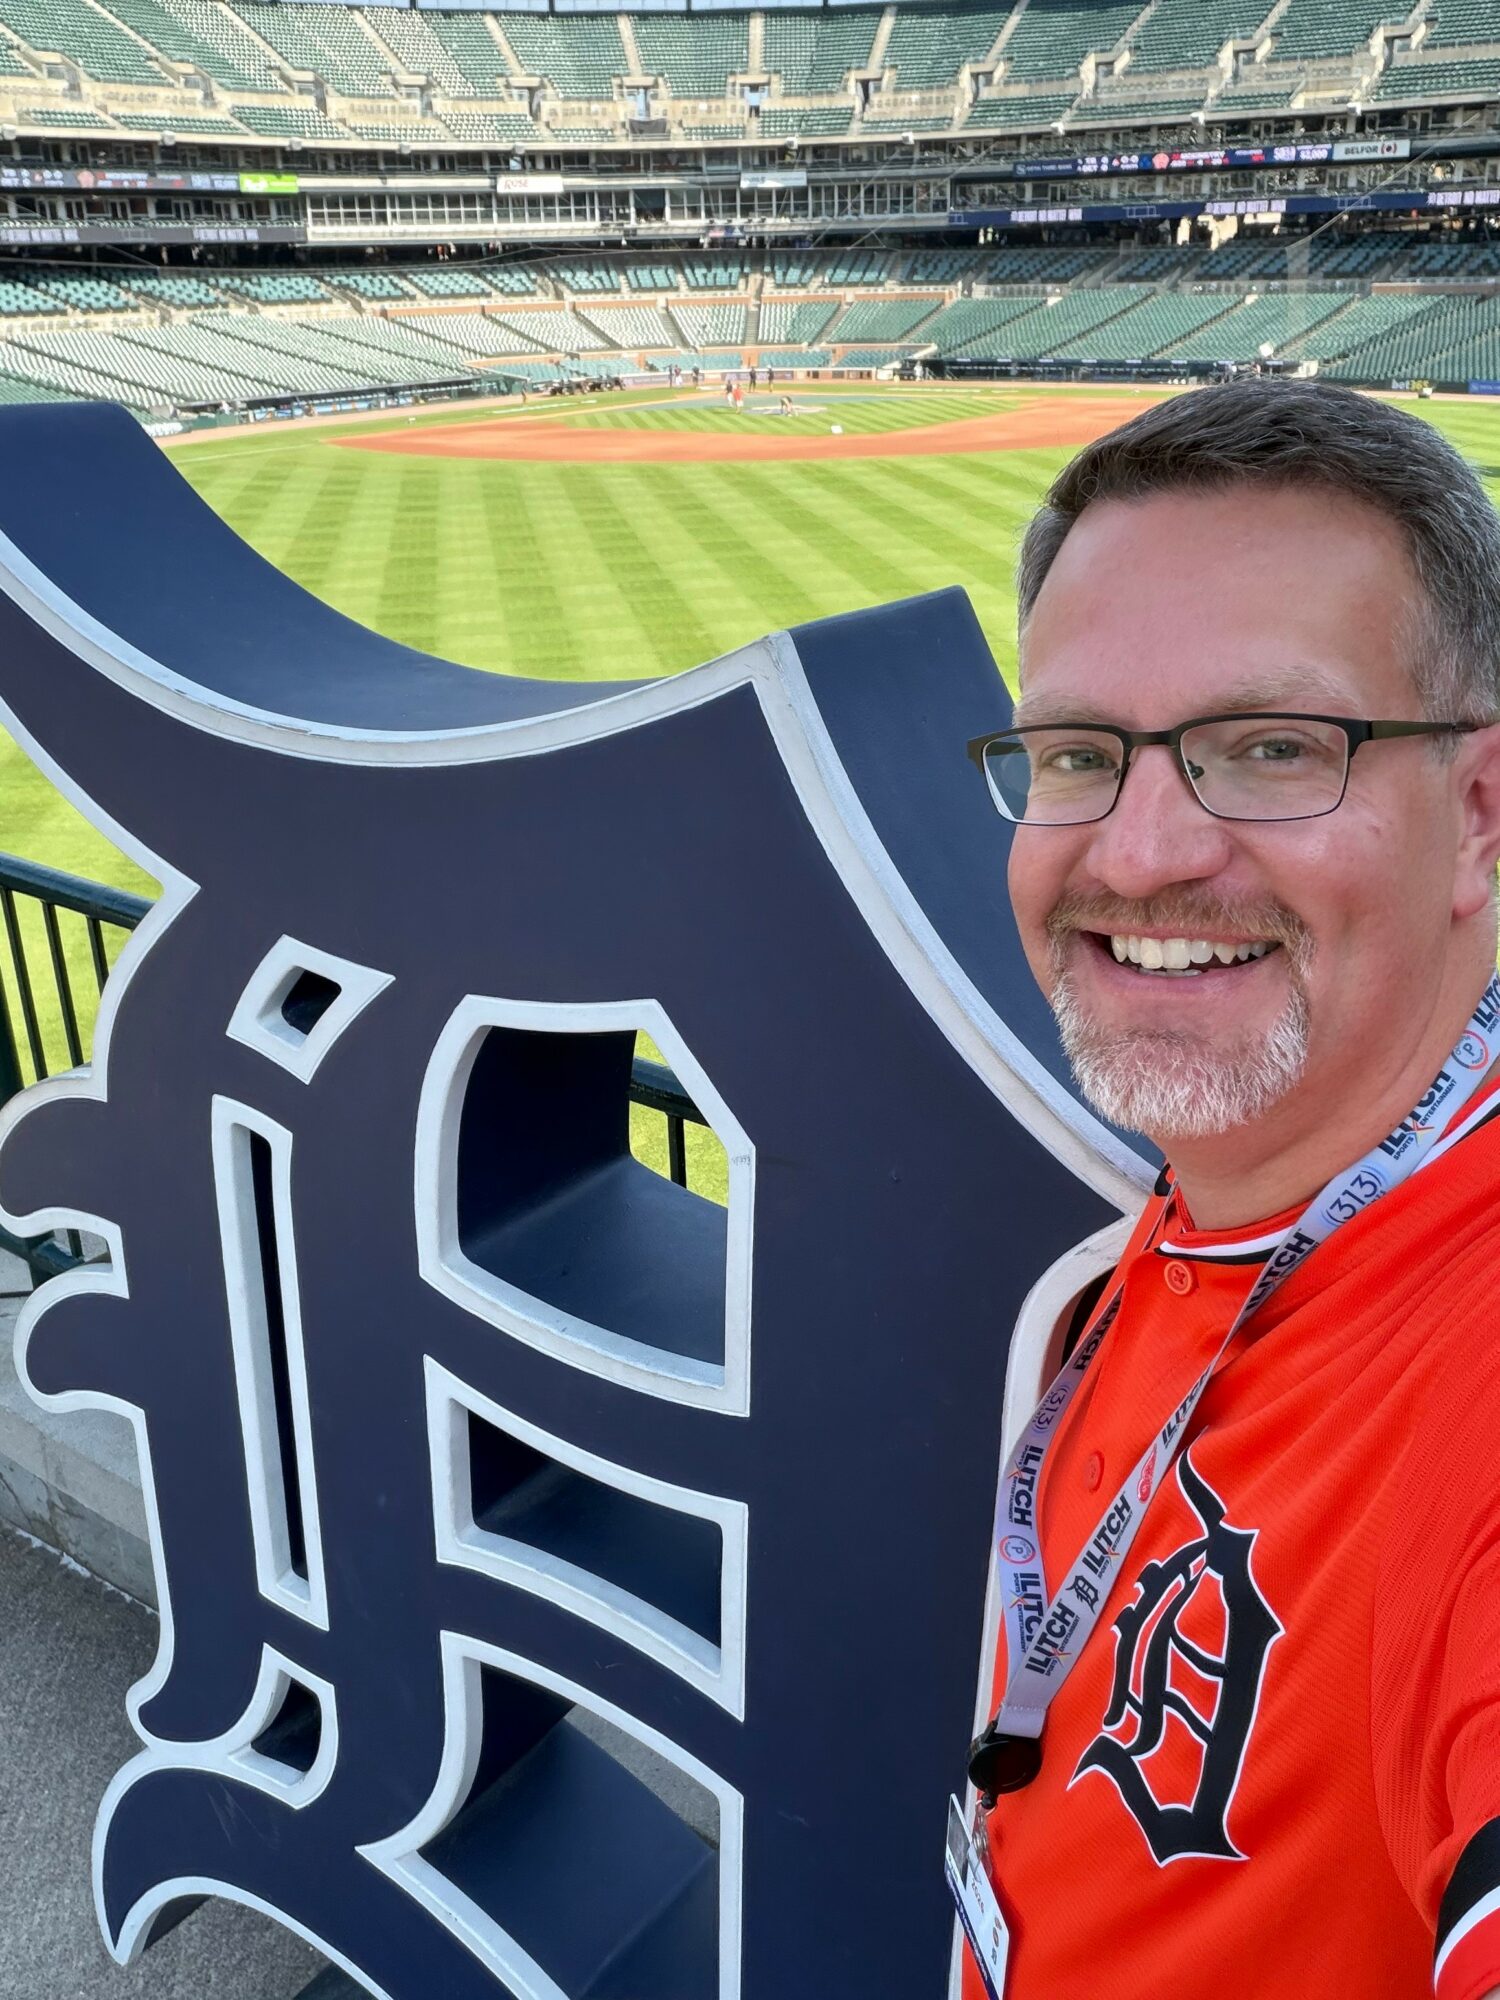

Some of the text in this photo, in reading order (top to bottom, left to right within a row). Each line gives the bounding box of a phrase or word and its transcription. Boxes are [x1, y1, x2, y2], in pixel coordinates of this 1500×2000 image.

[1343, 145, 1374, 155] BELFOR
[1420, 1079, 1457, 1126] ENTERTAINMENT
[1393, 1136, 1414, 1160] SPORTS
[1245, 1229, 1316, 1311] ILITCH
[1014, 1445, 1044, 1528] ILITCH
[1082, 1494, 1132, 1575] ILITCH
[1025, 1602, 1076, 1674] ILITCH
[1058, 1614, 1081, 1652] ENTERTAINMENT
